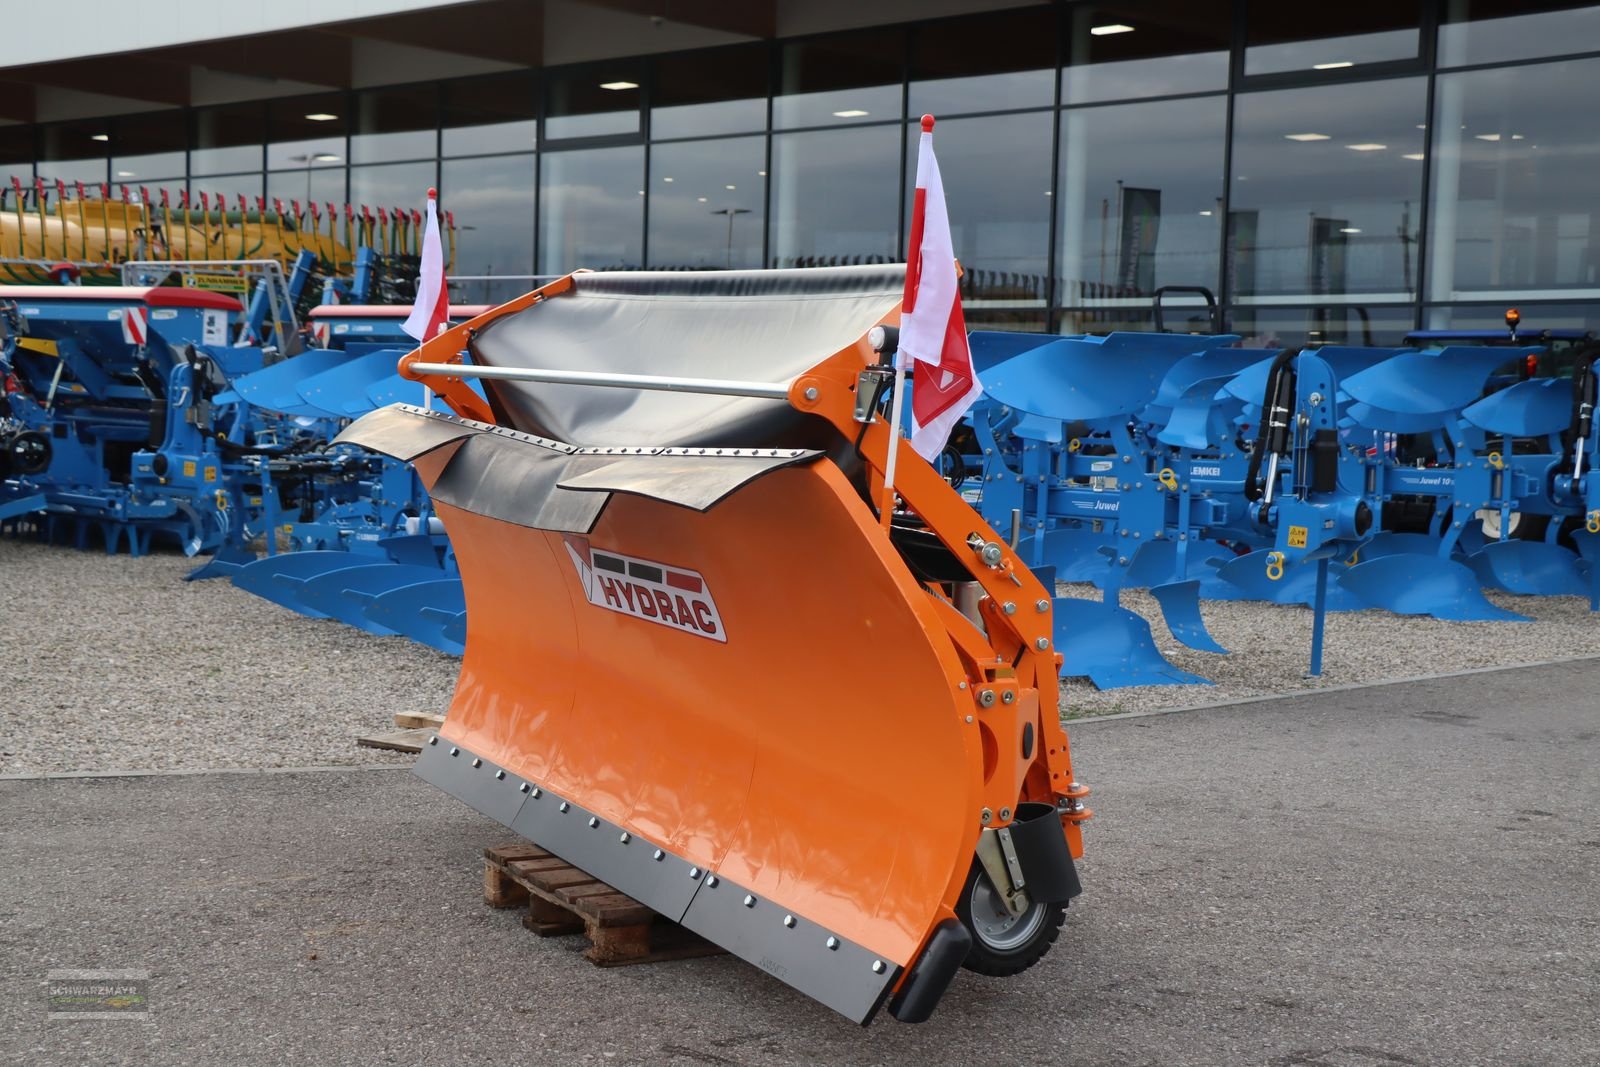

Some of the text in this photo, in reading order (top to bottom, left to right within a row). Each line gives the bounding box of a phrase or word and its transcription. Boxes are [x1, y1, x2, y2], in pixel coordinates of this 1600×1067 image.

[1419, 477, 1441, 485] Juwel
[1094, 499, 1120, 511] Juwel
[597, 575, 717, 634] HYDRAC
